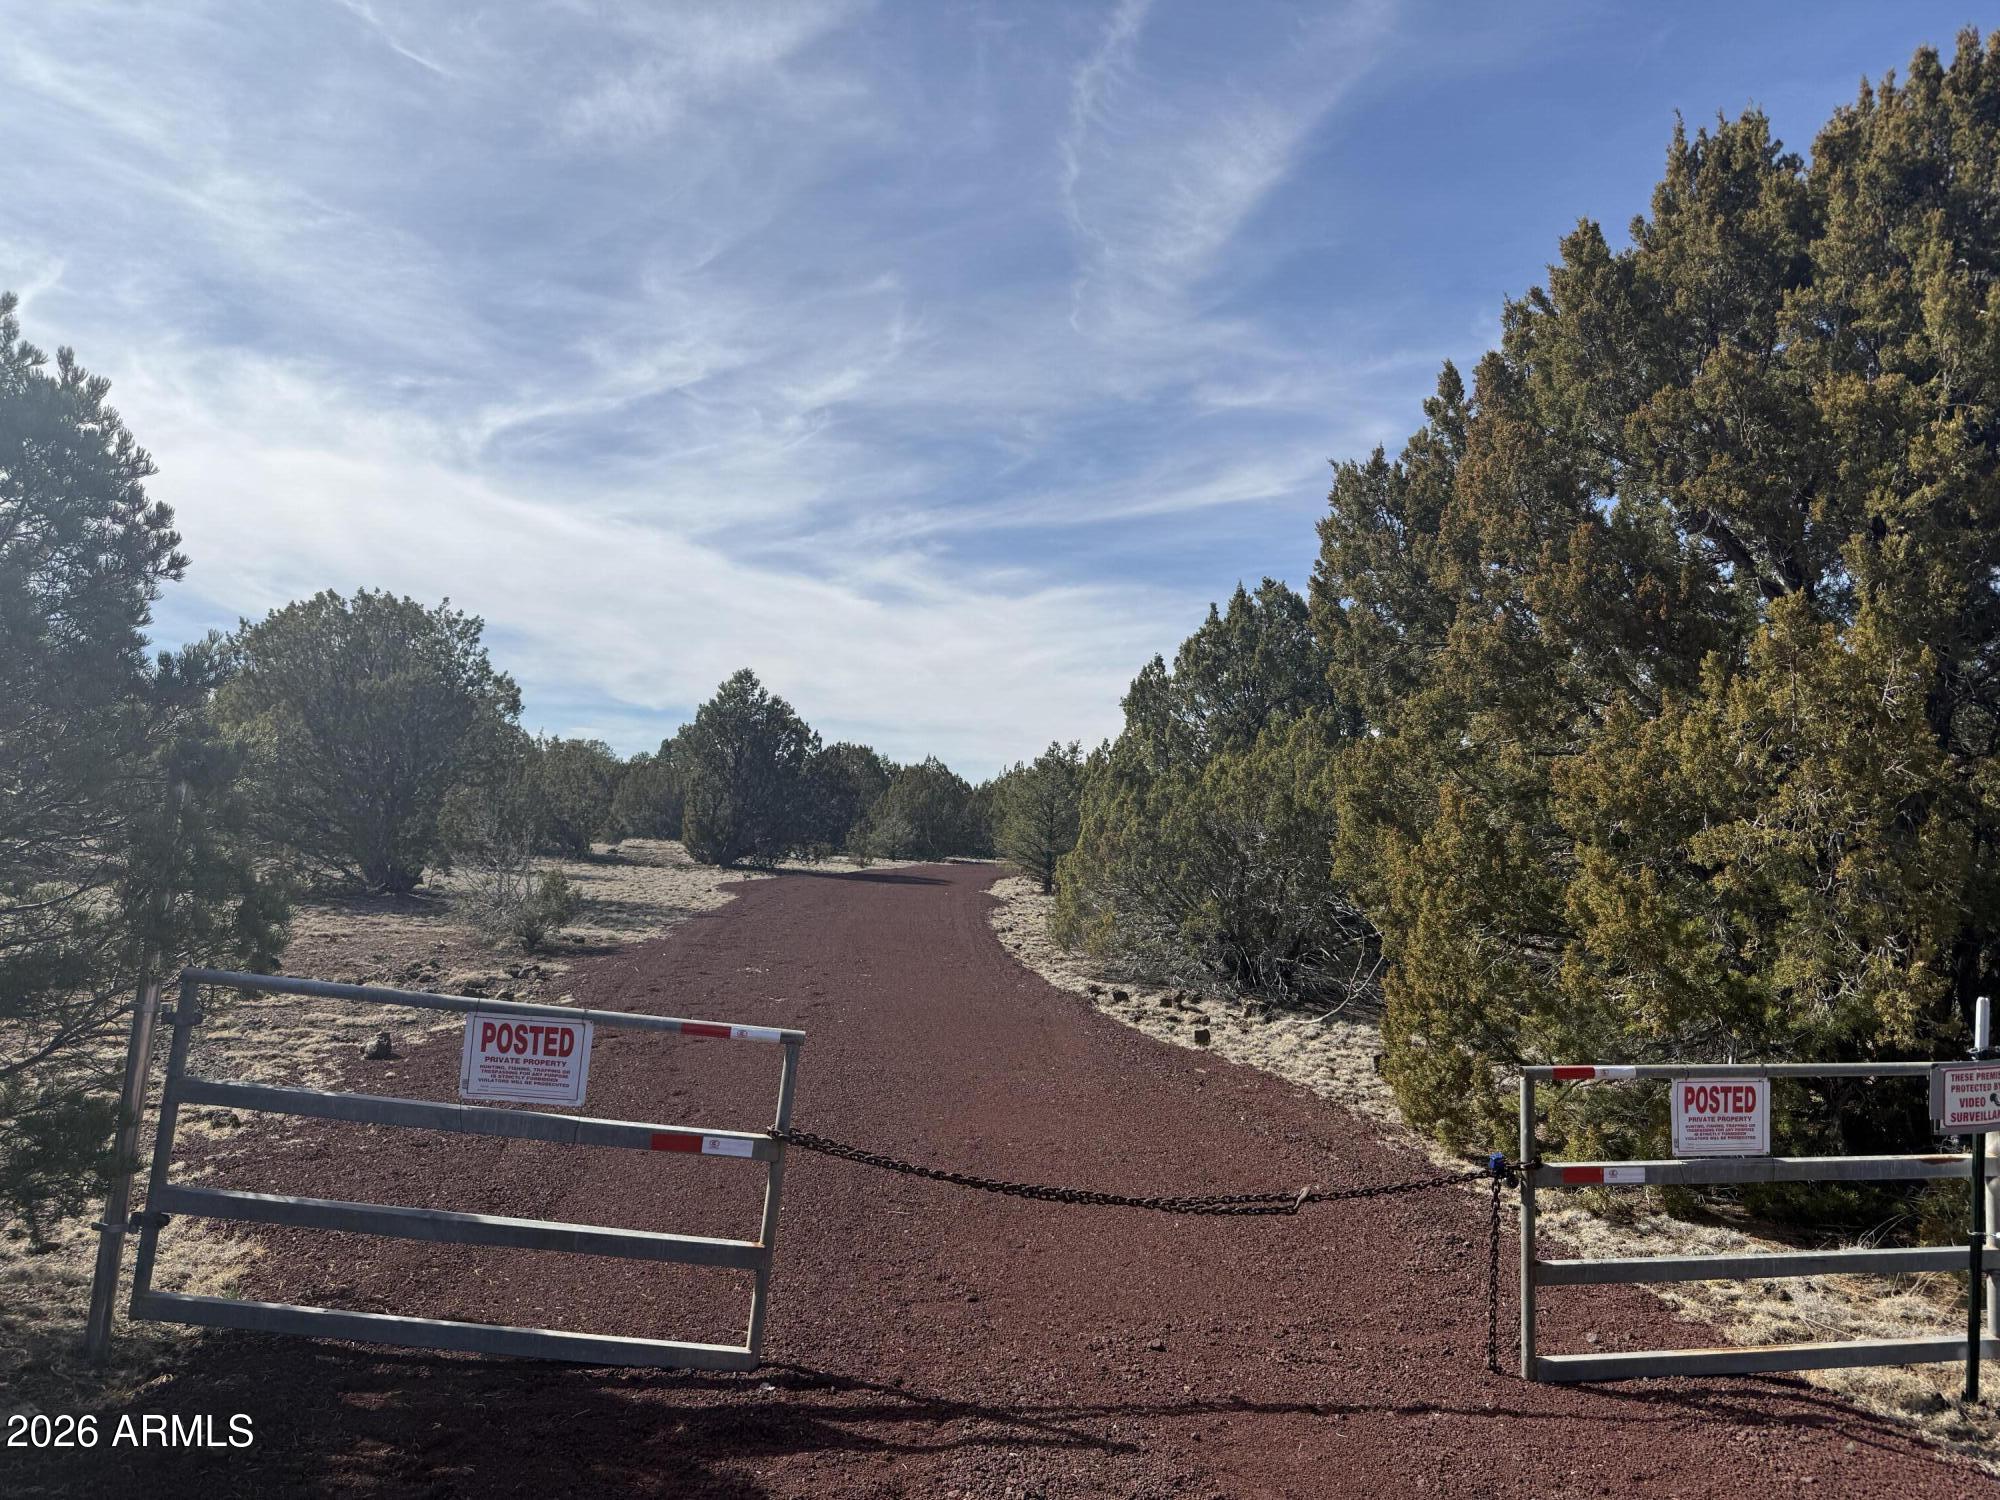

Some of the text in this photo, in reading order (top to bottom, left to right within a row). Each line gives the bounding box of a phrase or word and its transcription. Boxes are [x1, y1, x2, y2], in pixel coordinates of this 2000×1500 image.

[480, 1022, 575, 1058] POSTED
[485, 1056, 568, 1068] PRIVATE PROPERTY
[1951, 1073, 1974, 1082] THESE
[1951, 1083, 1992, 1092] PROTECTED
[1684, 1086, 1756, 1114] POSTED
[1960, 1097, 1986, 1108] VIDEO
